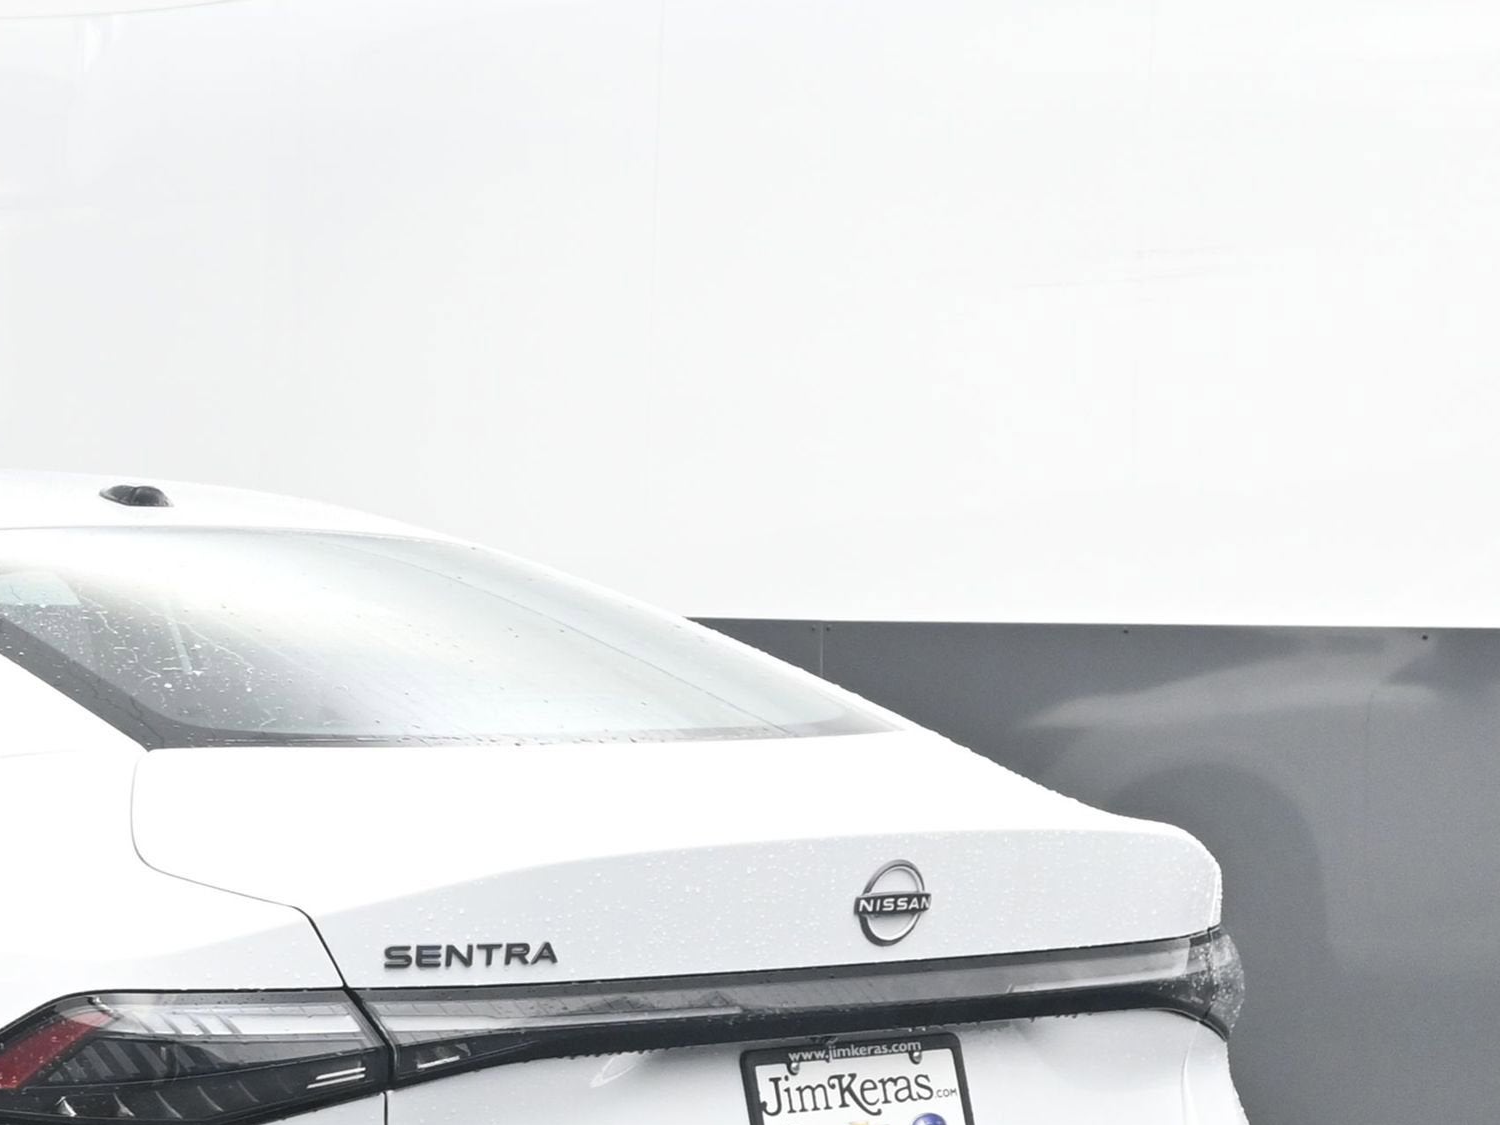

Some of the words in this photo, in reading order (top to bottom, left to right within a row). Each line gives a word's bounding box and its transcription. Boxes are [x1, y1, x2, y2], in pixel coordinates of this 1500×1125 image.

[858, 896, 931, 912] NISSAN
[383, 941, 559, 969] SENTRA
[788, 1041, 921, 1061] www.jimkeras.com
